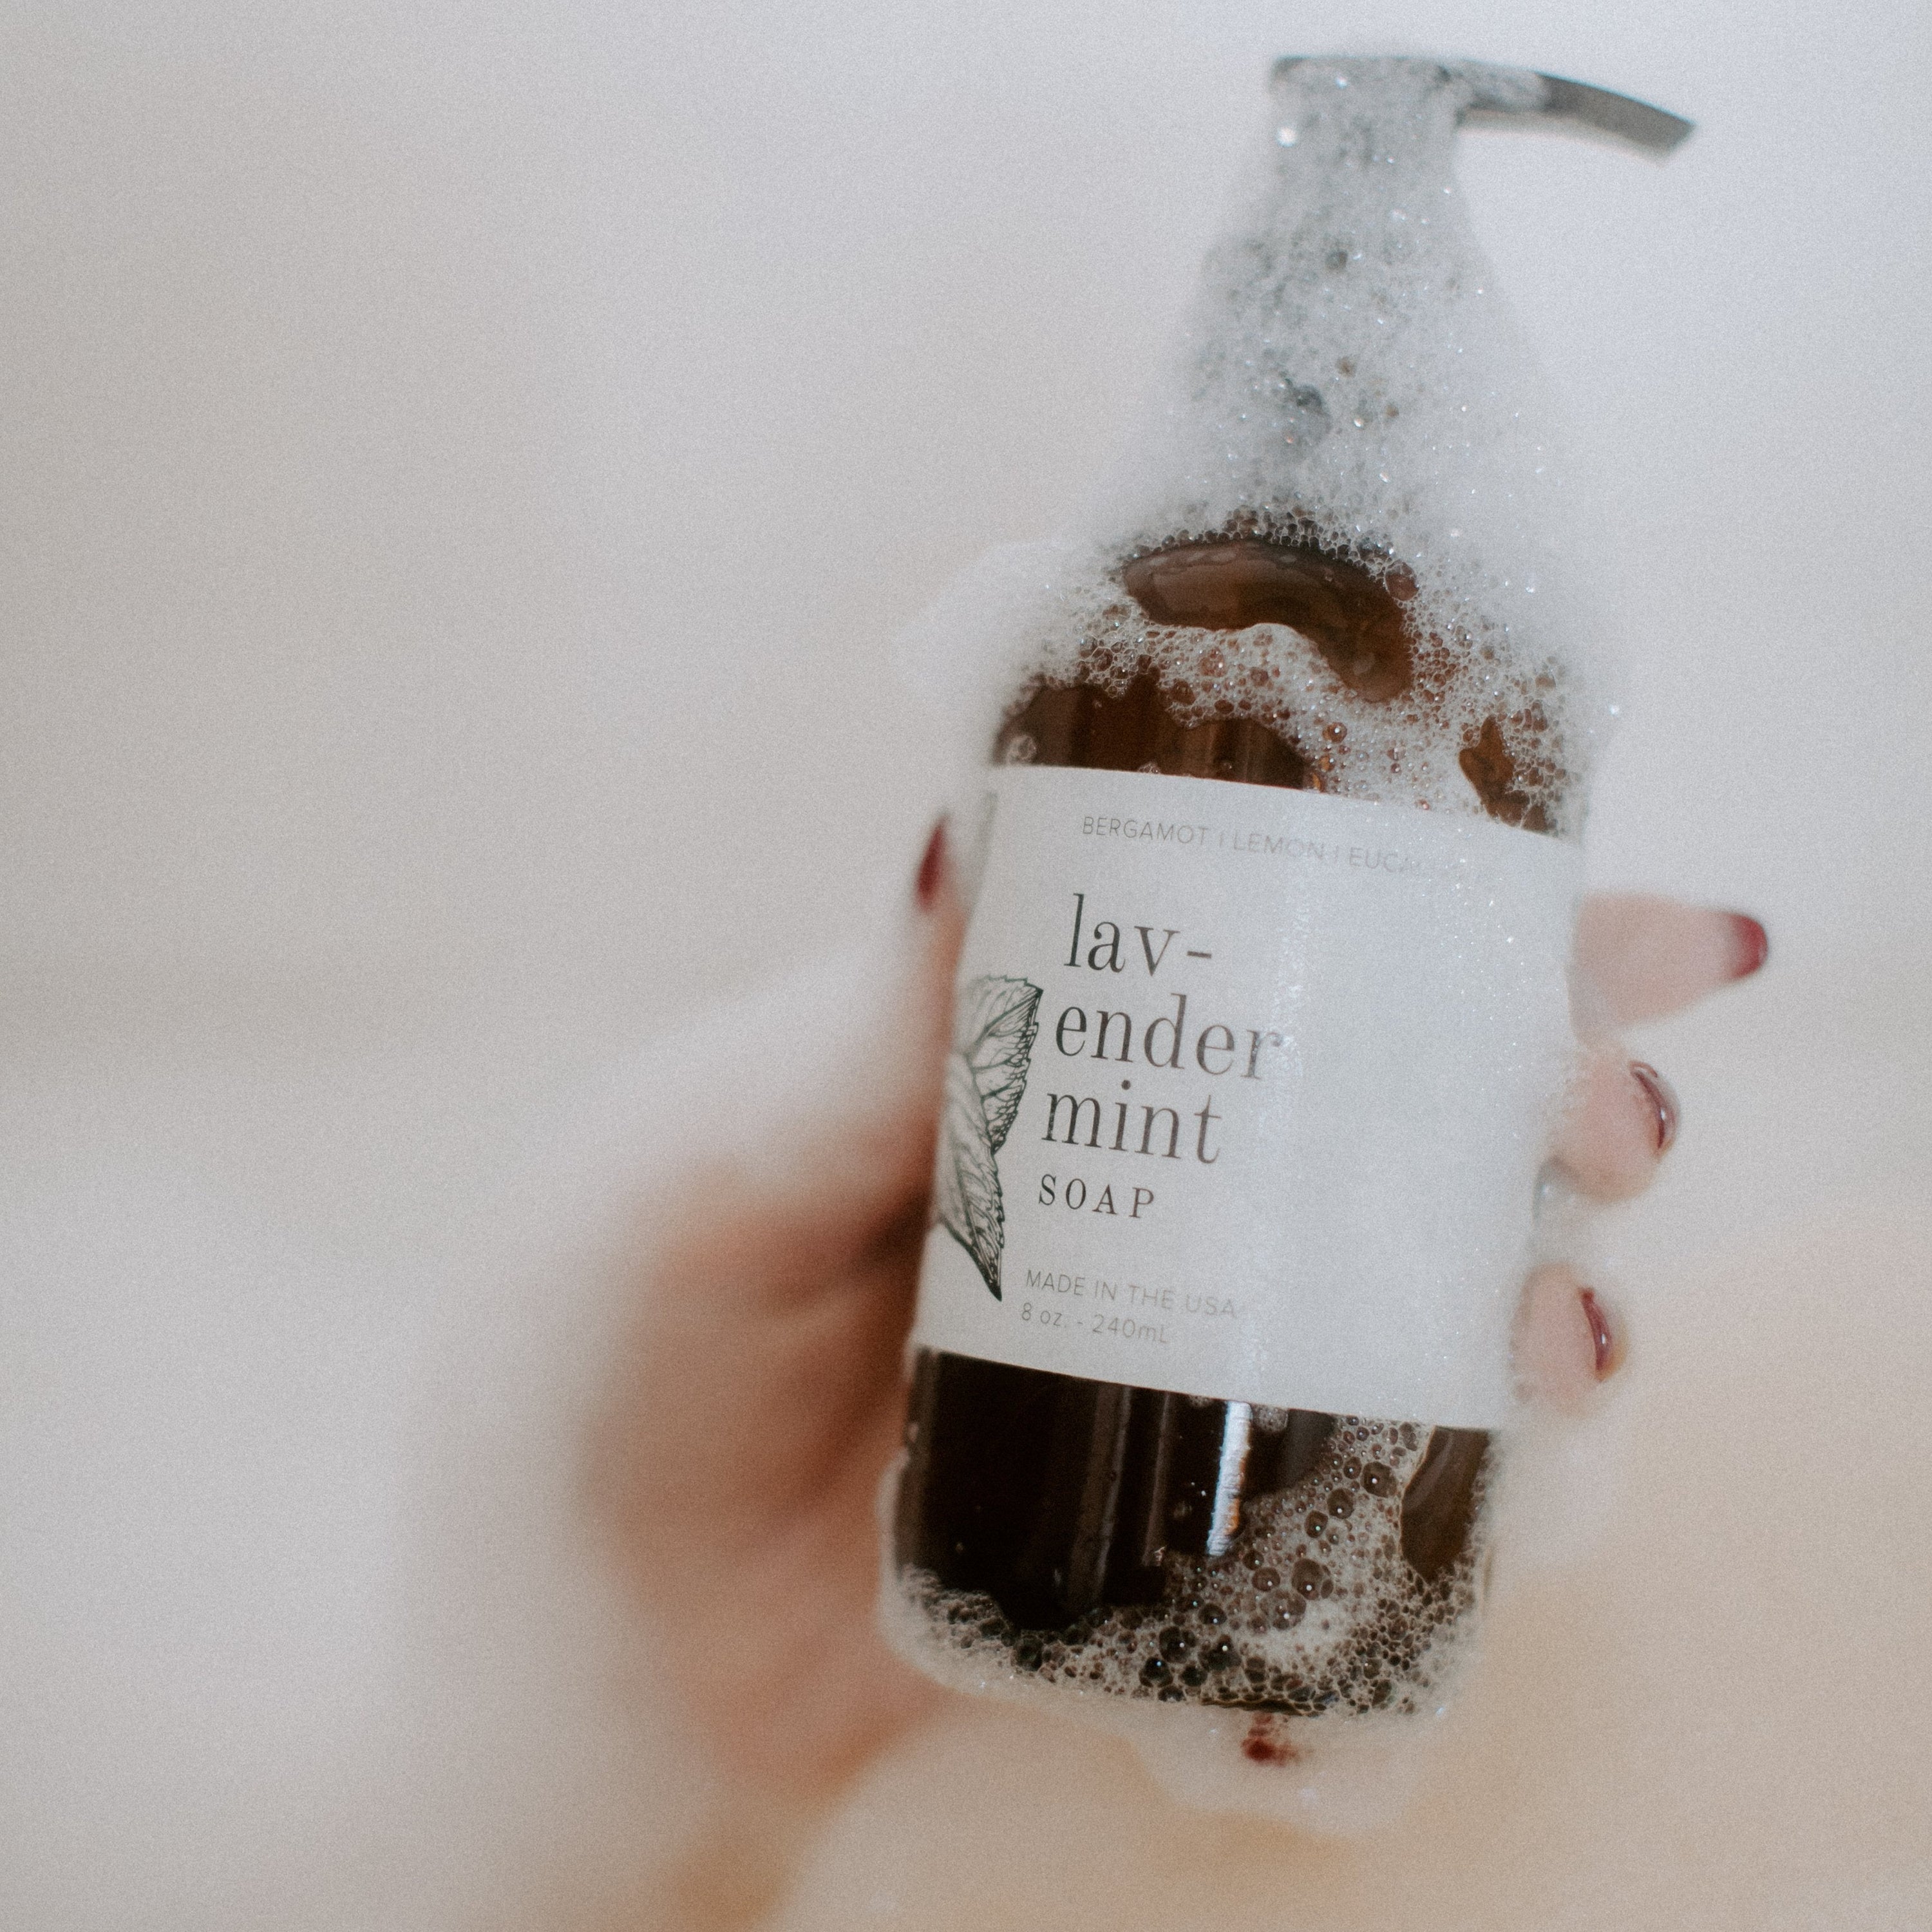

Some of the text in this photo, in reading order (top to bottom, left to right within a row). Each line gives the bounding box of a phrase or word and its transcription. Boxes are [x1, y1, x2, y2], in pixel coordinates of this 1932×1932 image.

[1082, 815, 1209, 846] BERGAMOT
[1232, 831, 1325, 860] LEMON
[1063, 893, 1213, 977] lav-
[1056, 992, 1285, 1080] ender
[1041, 1079, 1222, 1164] mint
[1038, 1173, 1155, 1219] SOAP
[1025, 1269, 1238, 1320] MADE IN THE USA
[1021, 1301, 1033, 1322] 8
[1039, 1310, 1068, 1329] oz.
[1092, 1314, 1170, 1345] 240mL
